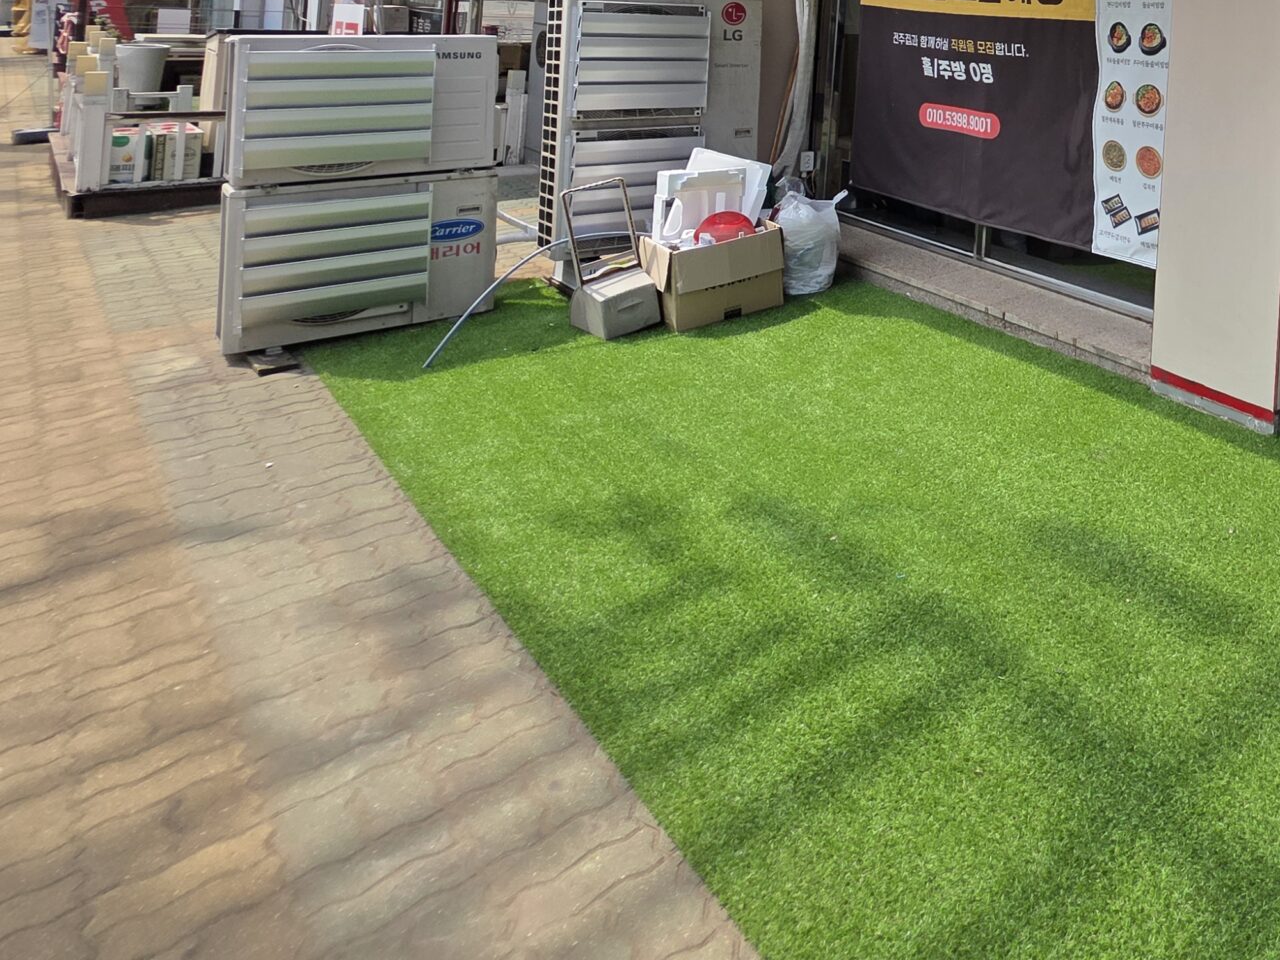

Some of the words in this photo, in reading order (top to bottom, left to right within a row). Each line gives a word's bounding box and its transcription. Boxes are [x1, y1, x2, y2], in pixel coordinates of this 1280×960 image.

[723, 29, 743, 41] LG
[893, 31, 918, 47] 전주집과
[951, 38, 976, 53] 직원을
[977, 41, 1030, 58] 모집합니다.
[435, 51, 482, 60] AMSUNG
[926, 107, 992, 133] 010.5398.9001
